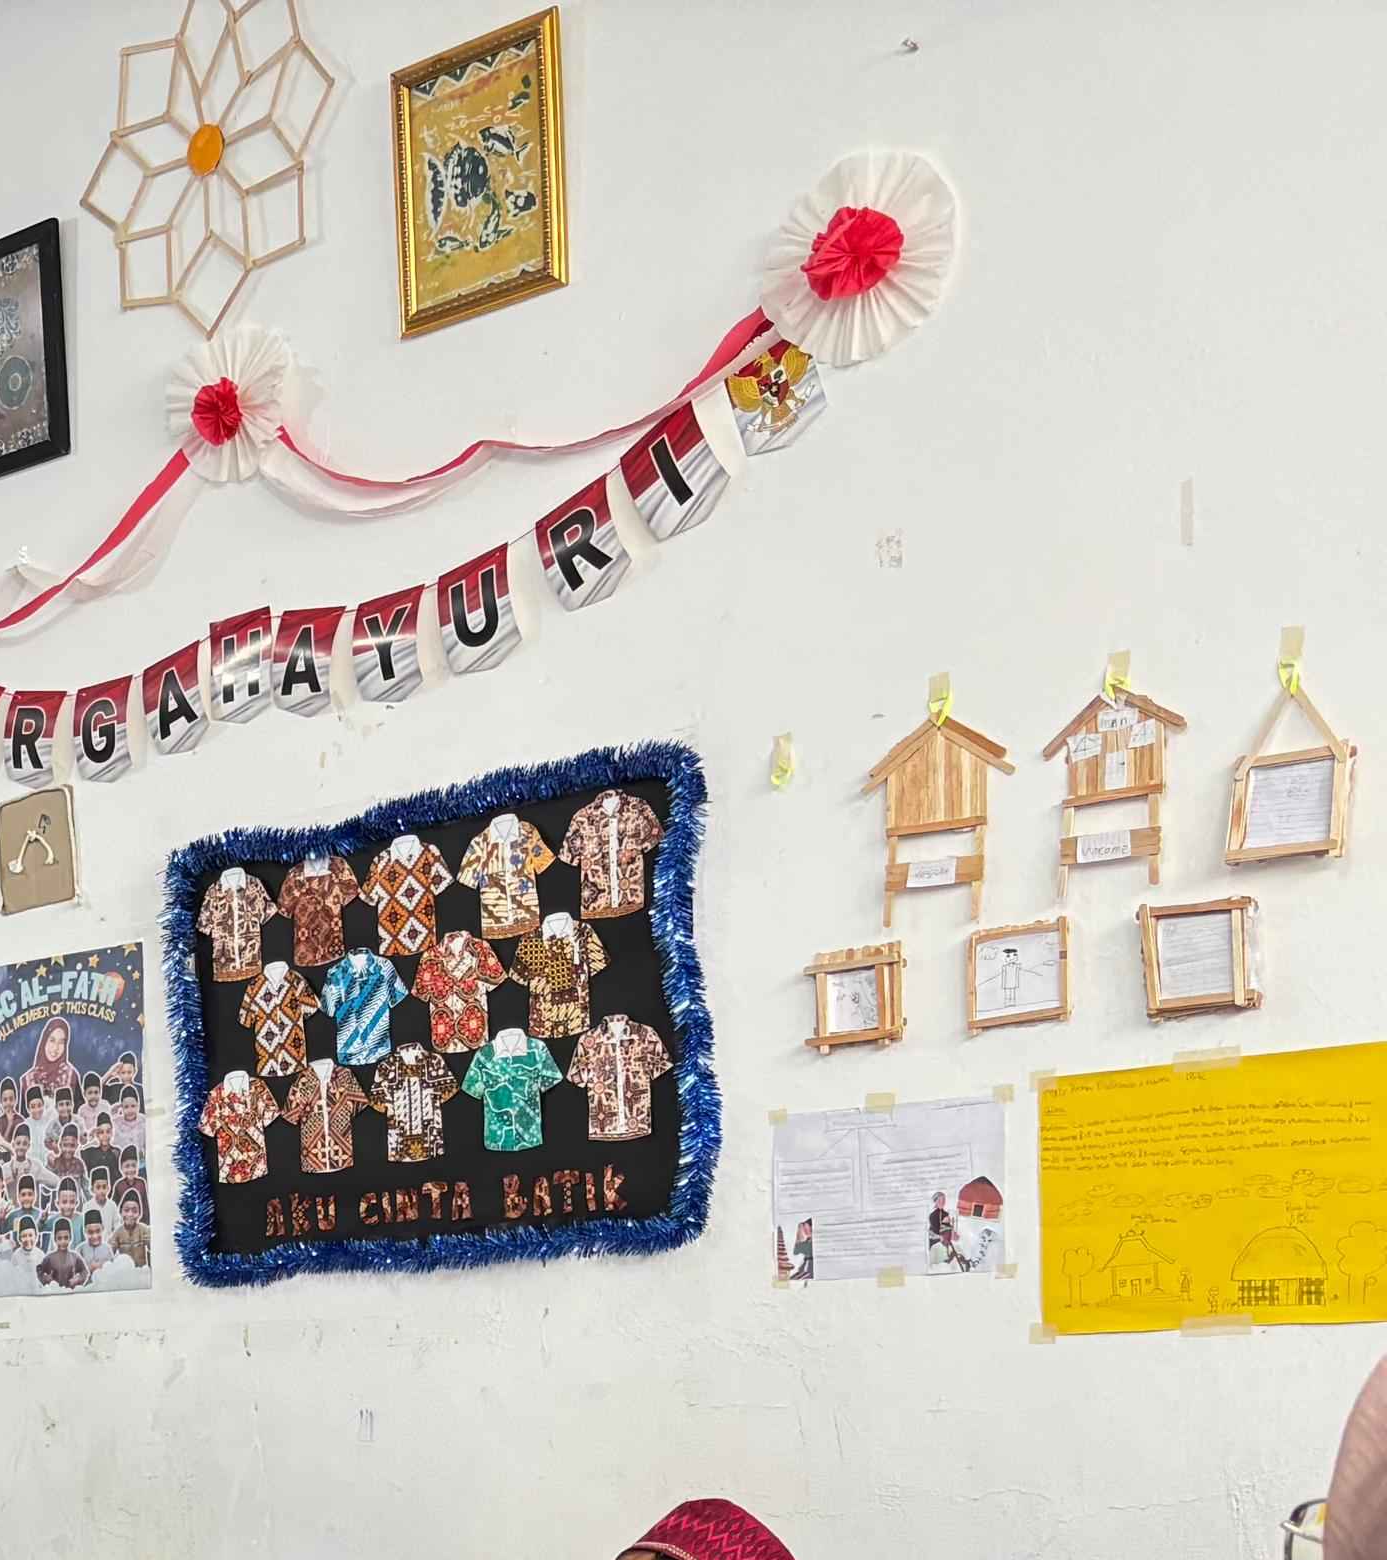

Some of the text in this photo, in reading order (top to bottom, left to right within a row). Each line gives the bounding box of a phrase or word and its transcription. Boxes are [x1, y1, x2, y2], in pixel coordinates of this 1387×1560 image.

[20, 970, 118, 1010] AL-FATH
[12, 1006, 50, 1030] MEMBER
[50, 1002, 65, 1015] OF
[66, 1002, 86, 1015] THIS
[87, 1003, 116, 1023] CLASS
[265, 1162, 627, 1239] AKU CINTA BATIK
